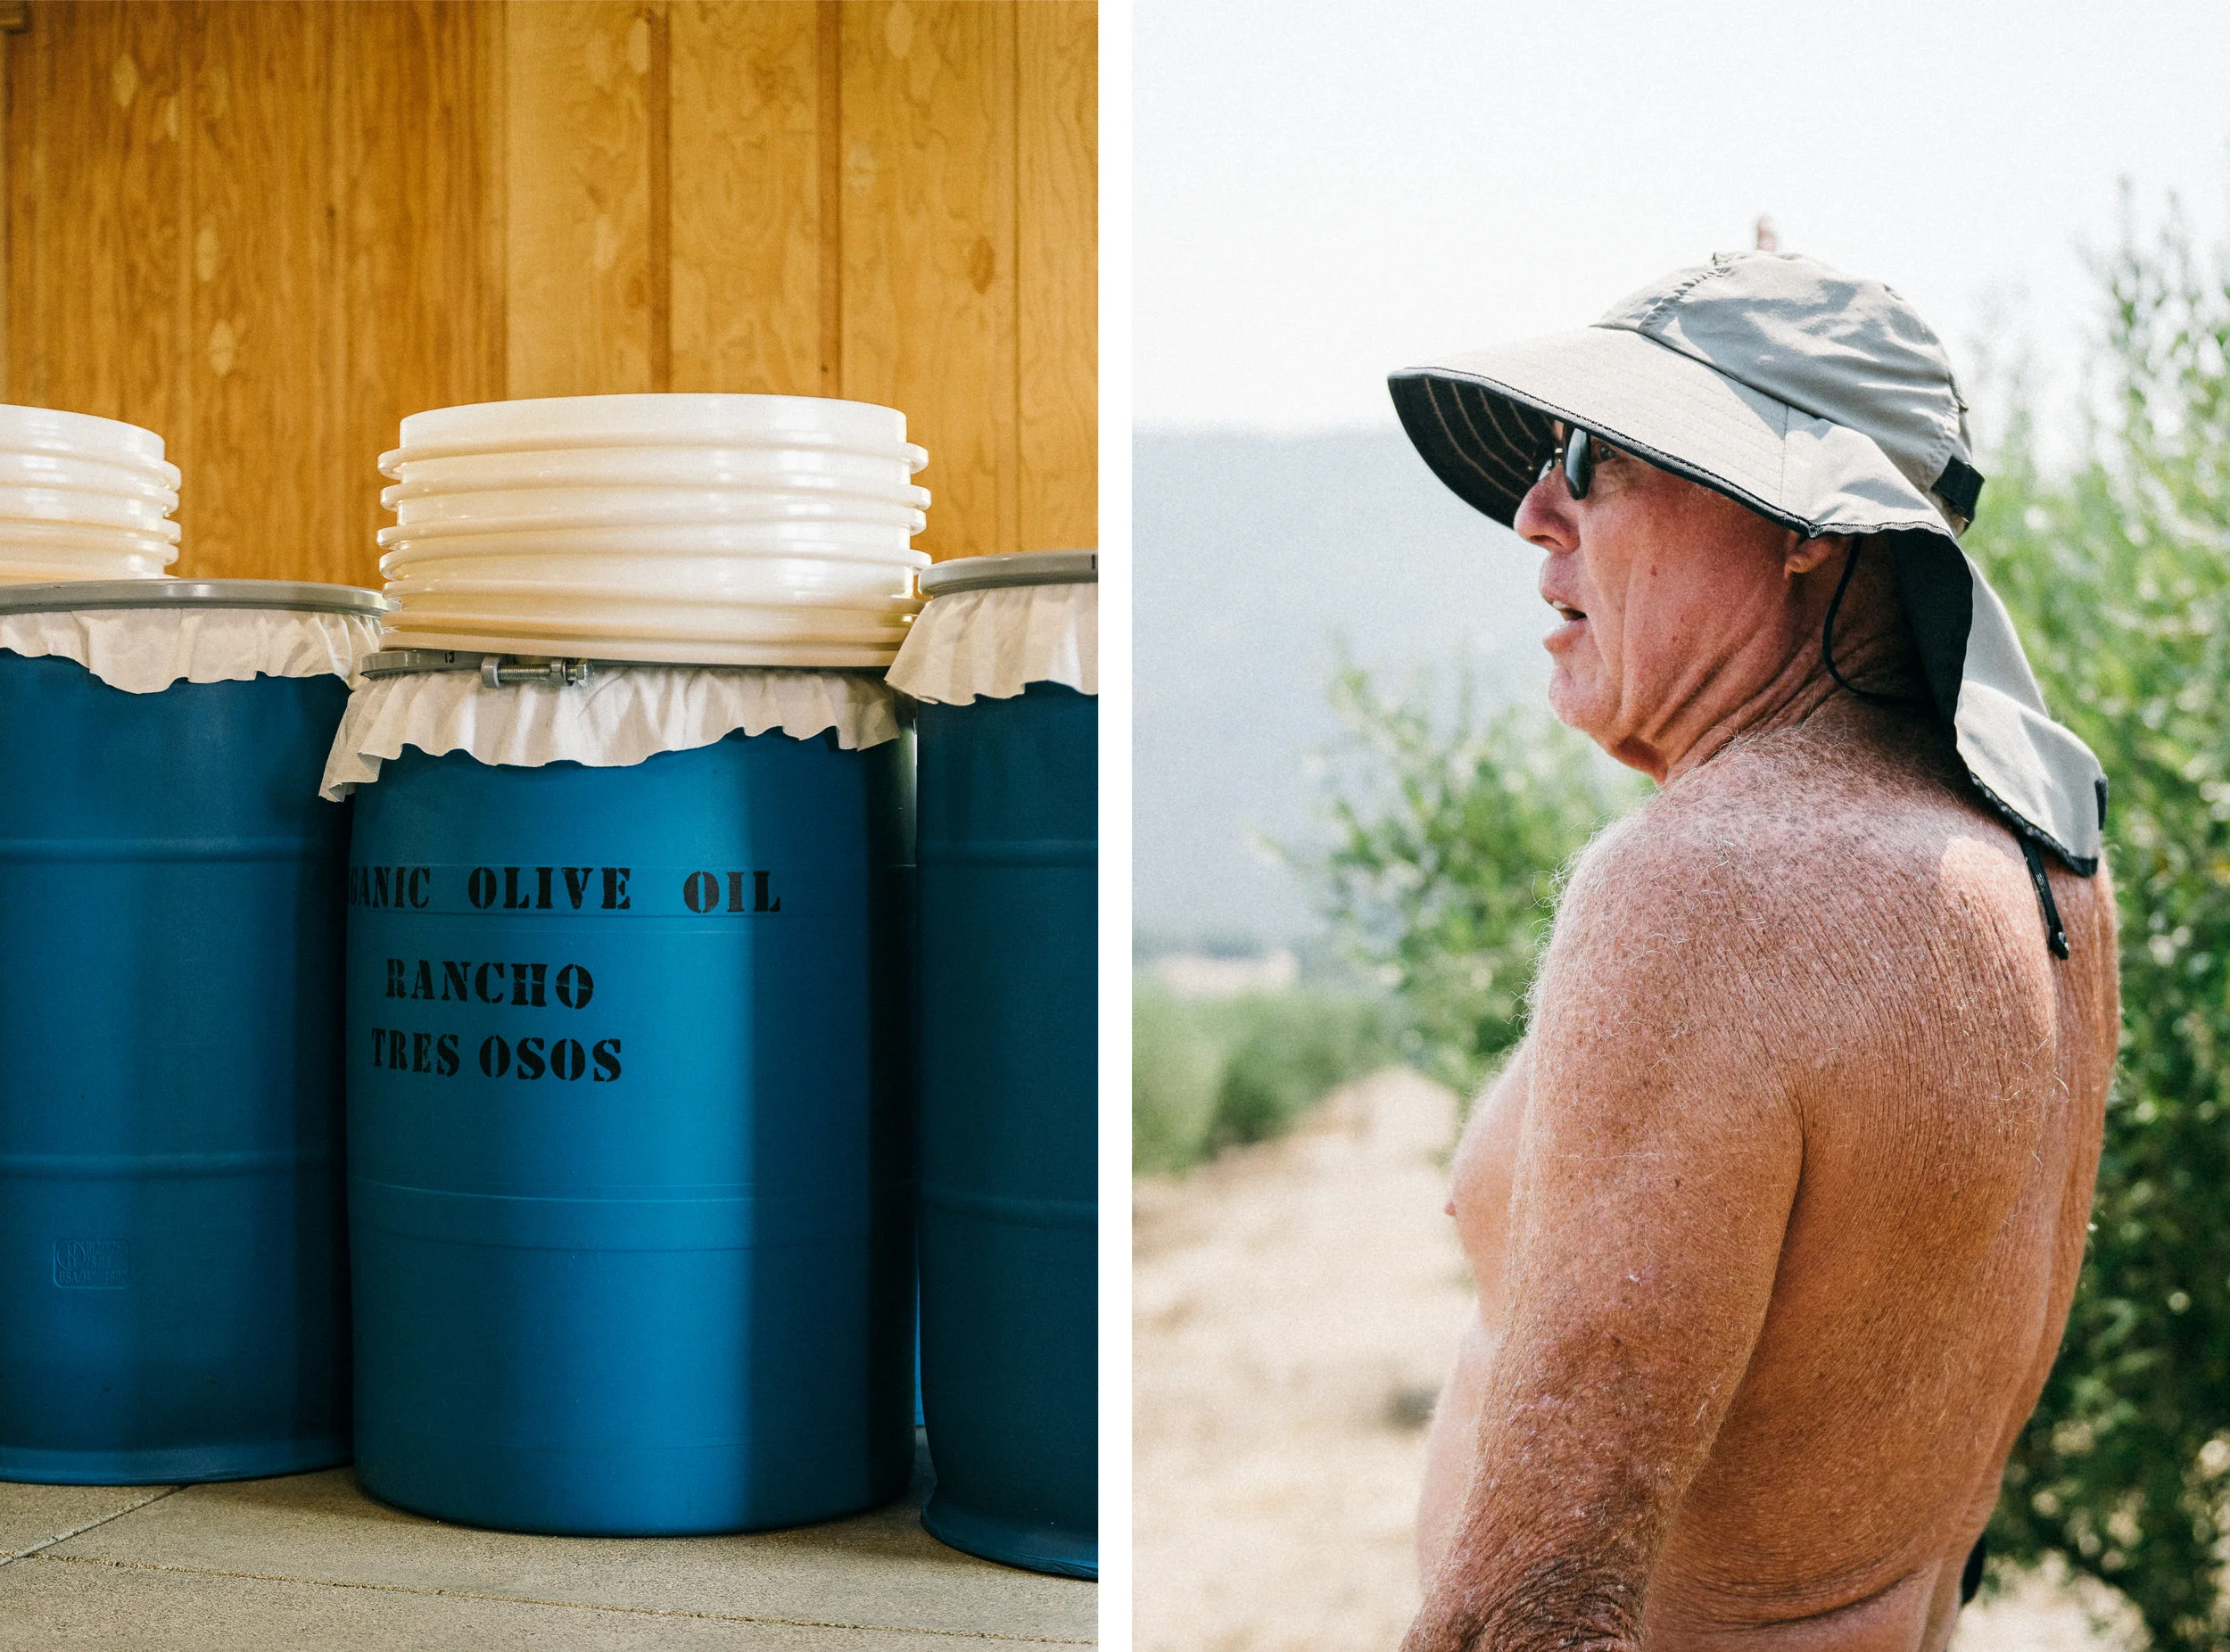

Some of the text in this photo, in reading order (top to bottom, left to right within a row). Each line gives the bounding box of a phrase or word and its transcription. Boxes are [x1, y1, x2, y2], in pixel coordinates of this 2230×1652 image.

[467, 866, 631, 910] OLIVE
[683, 871, 781, 913] OIL
[385, 958, 594, 1010] RANCHO
[371, 1028, 622, 1082] TRES OSOS
